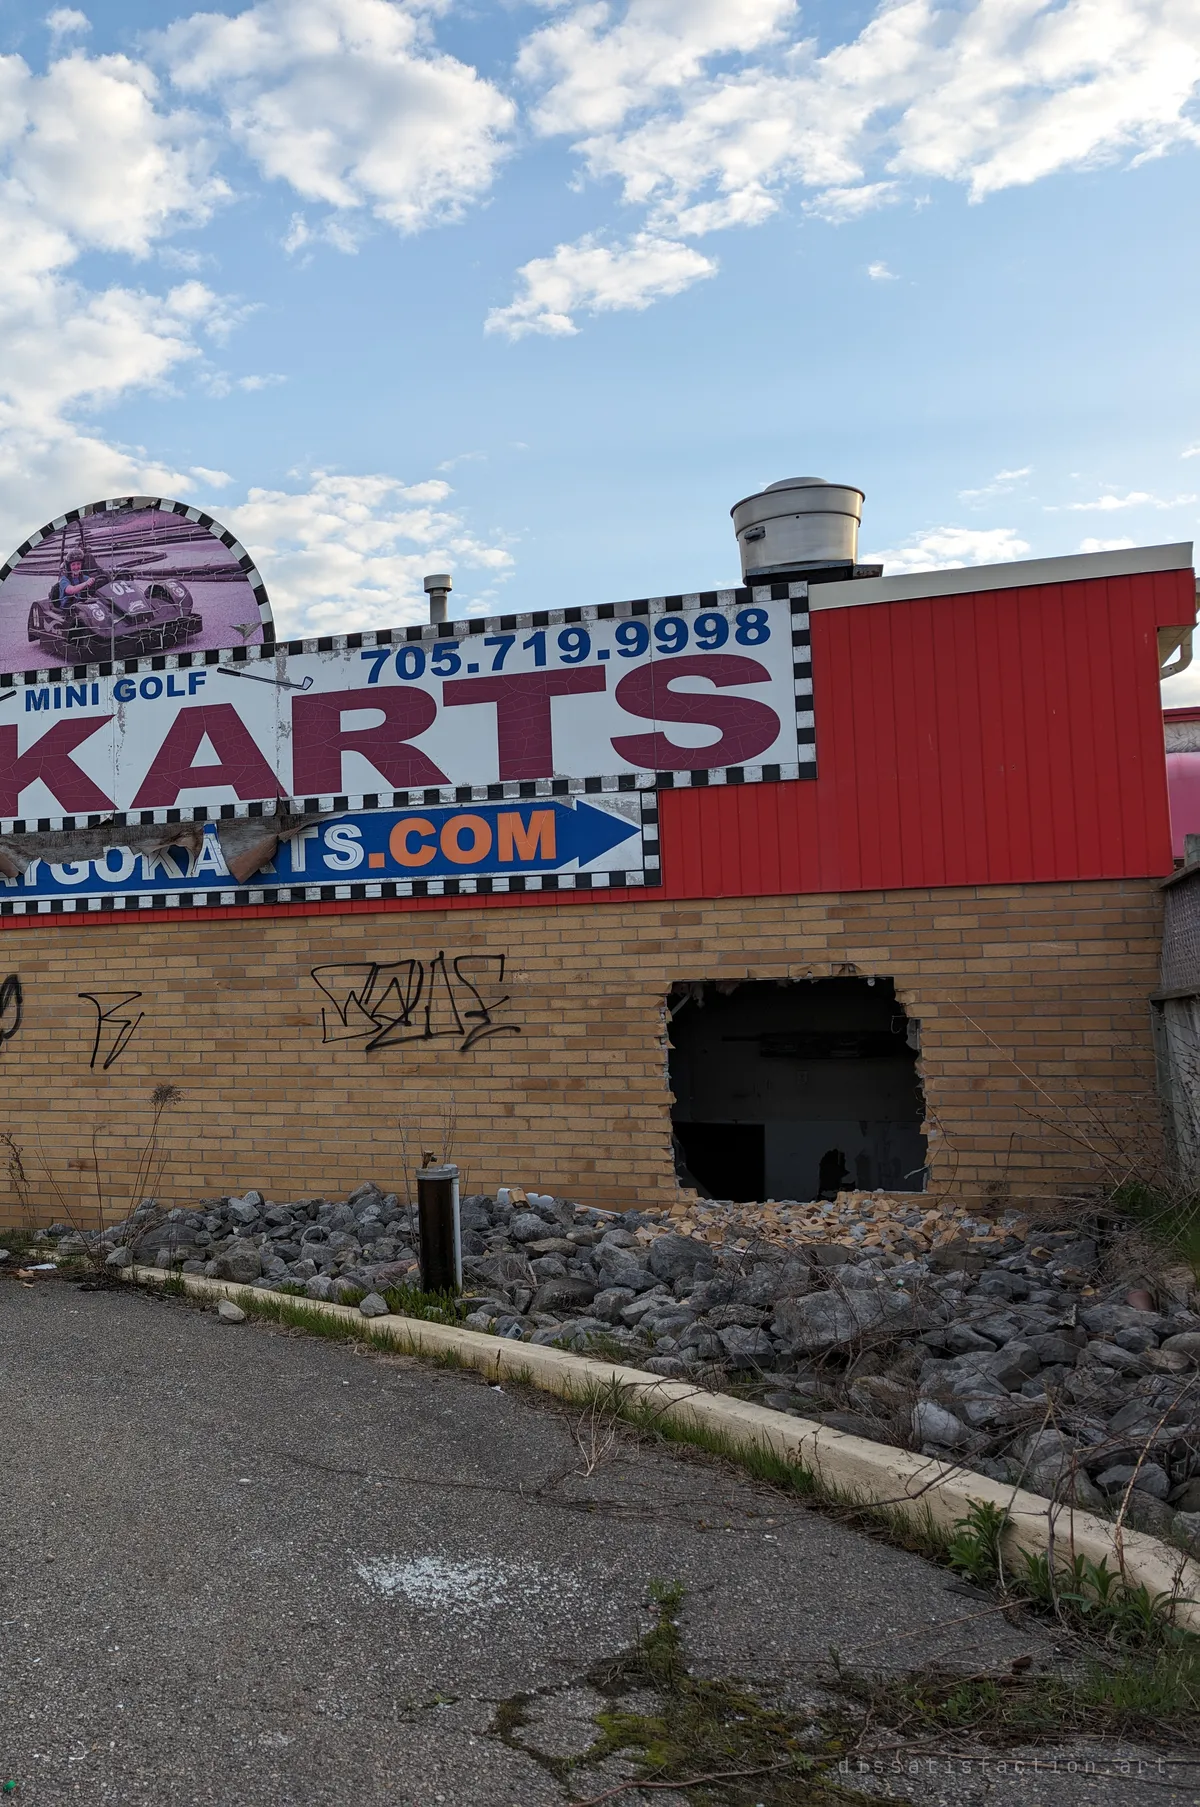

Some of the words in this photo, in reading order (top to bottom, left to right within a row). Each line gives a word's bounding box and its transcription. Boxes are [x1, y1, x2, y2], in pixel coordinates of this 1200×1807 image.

[361, 607, 772, 685] 705.719.9998
[24, 683, 100, 712] MINI
[113, 670, 208, 703] GOLF
